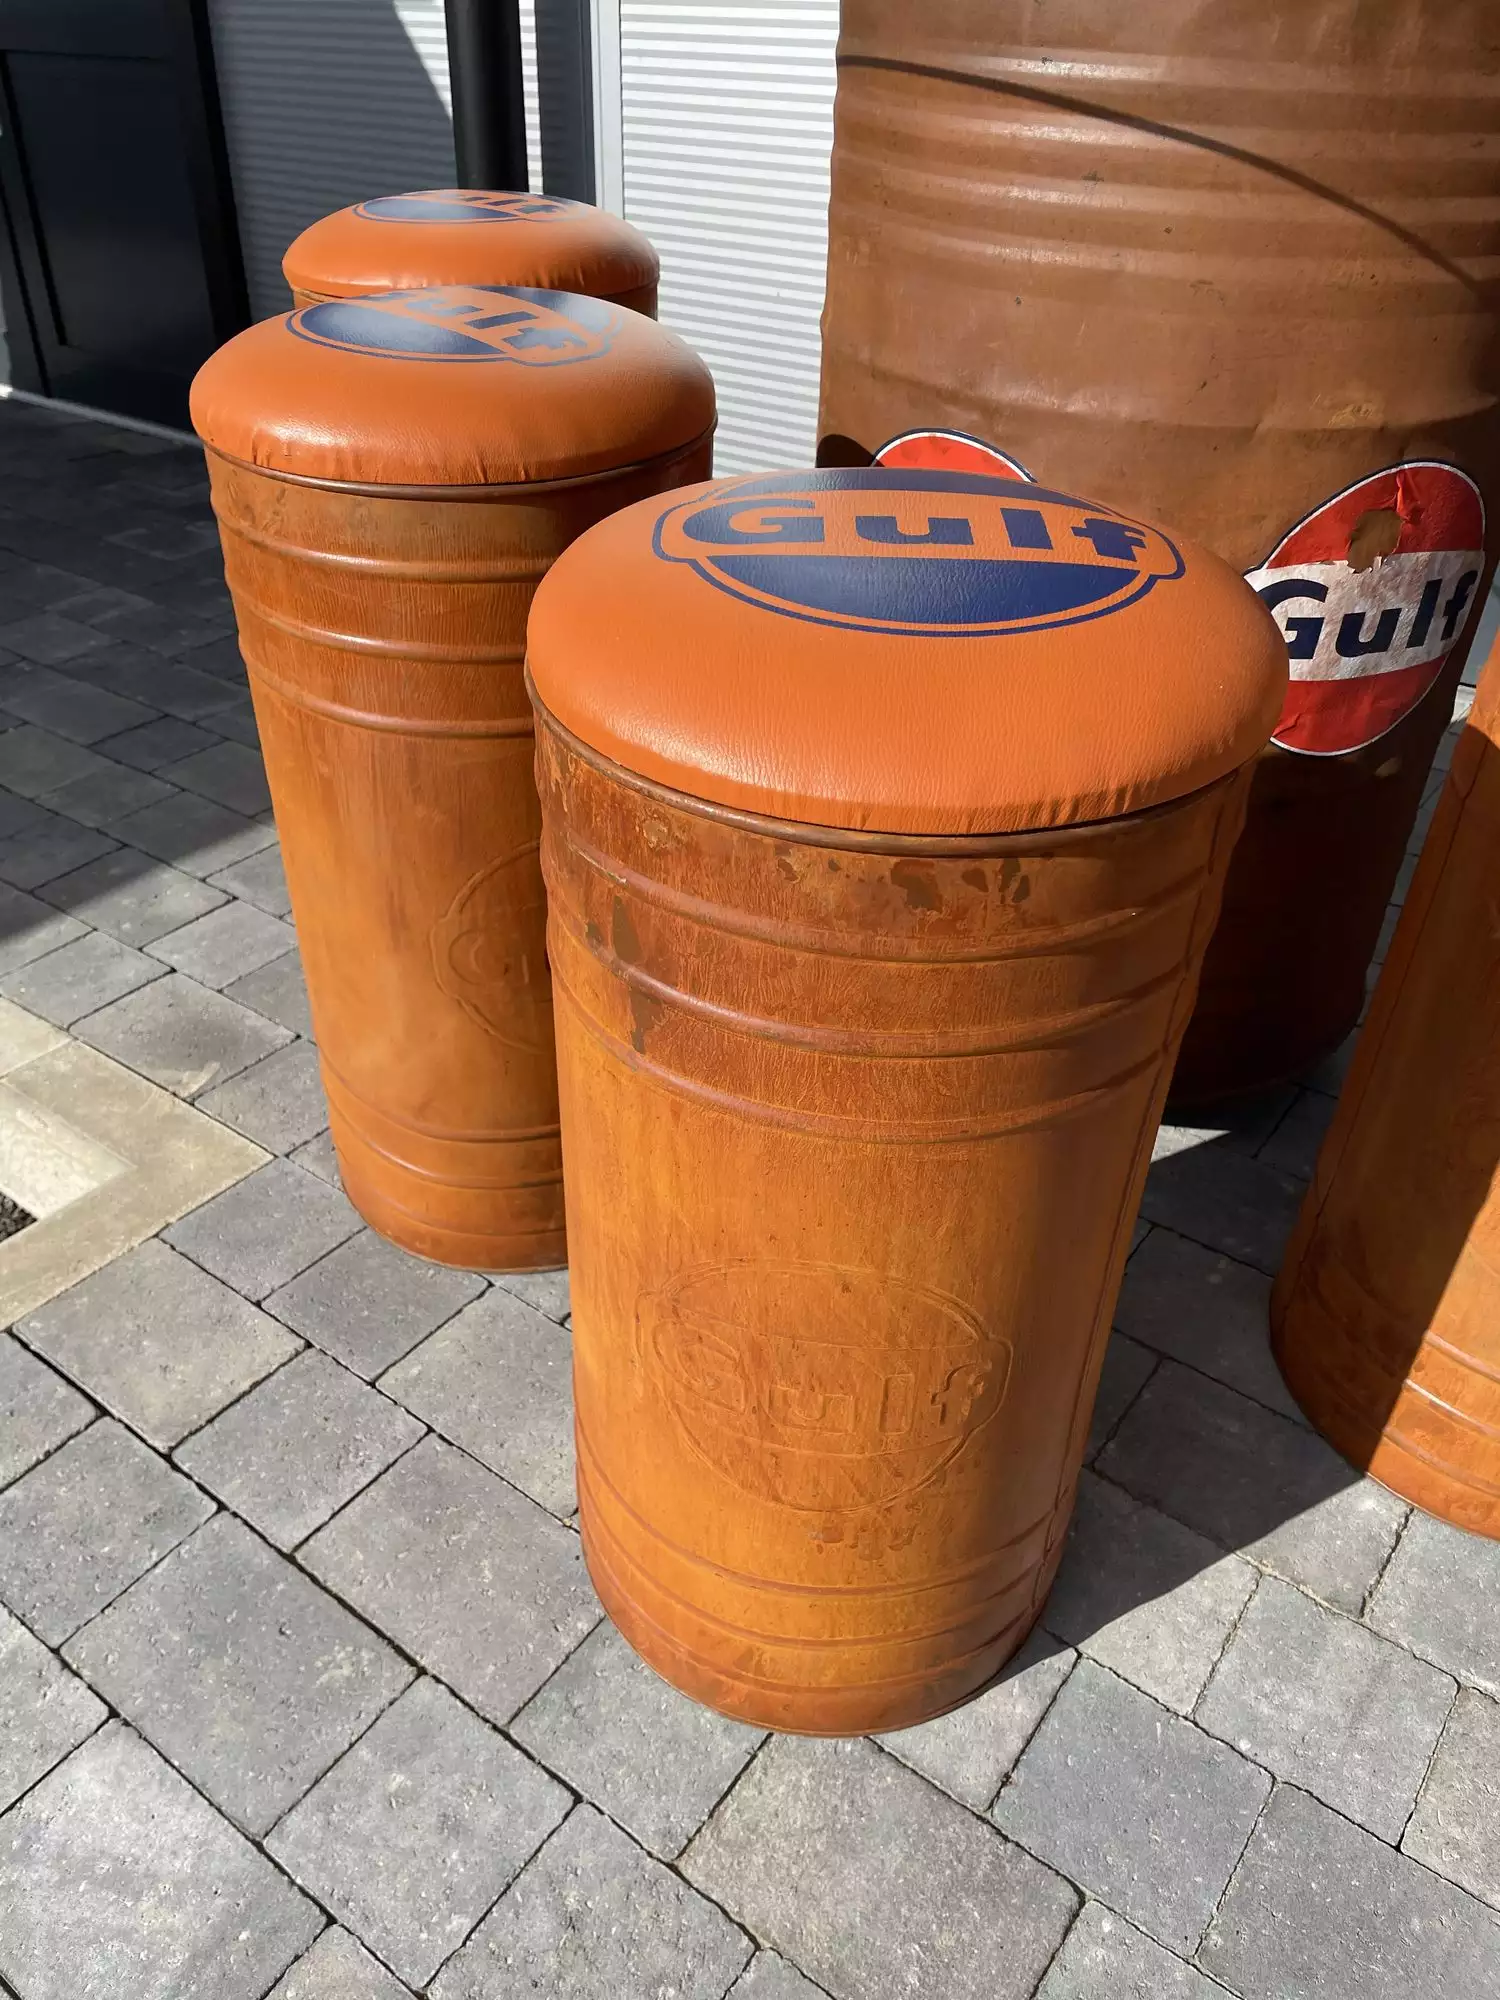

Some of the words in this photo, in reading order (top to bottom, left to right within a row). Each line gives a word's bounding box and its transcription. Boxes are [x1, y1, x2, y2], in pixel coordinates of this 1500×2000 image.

[682, 498, 1146, 562] Gulf
[1257, 570, 1478, 660] Gulf
[653, 1320, 992, 1434] Gulf
